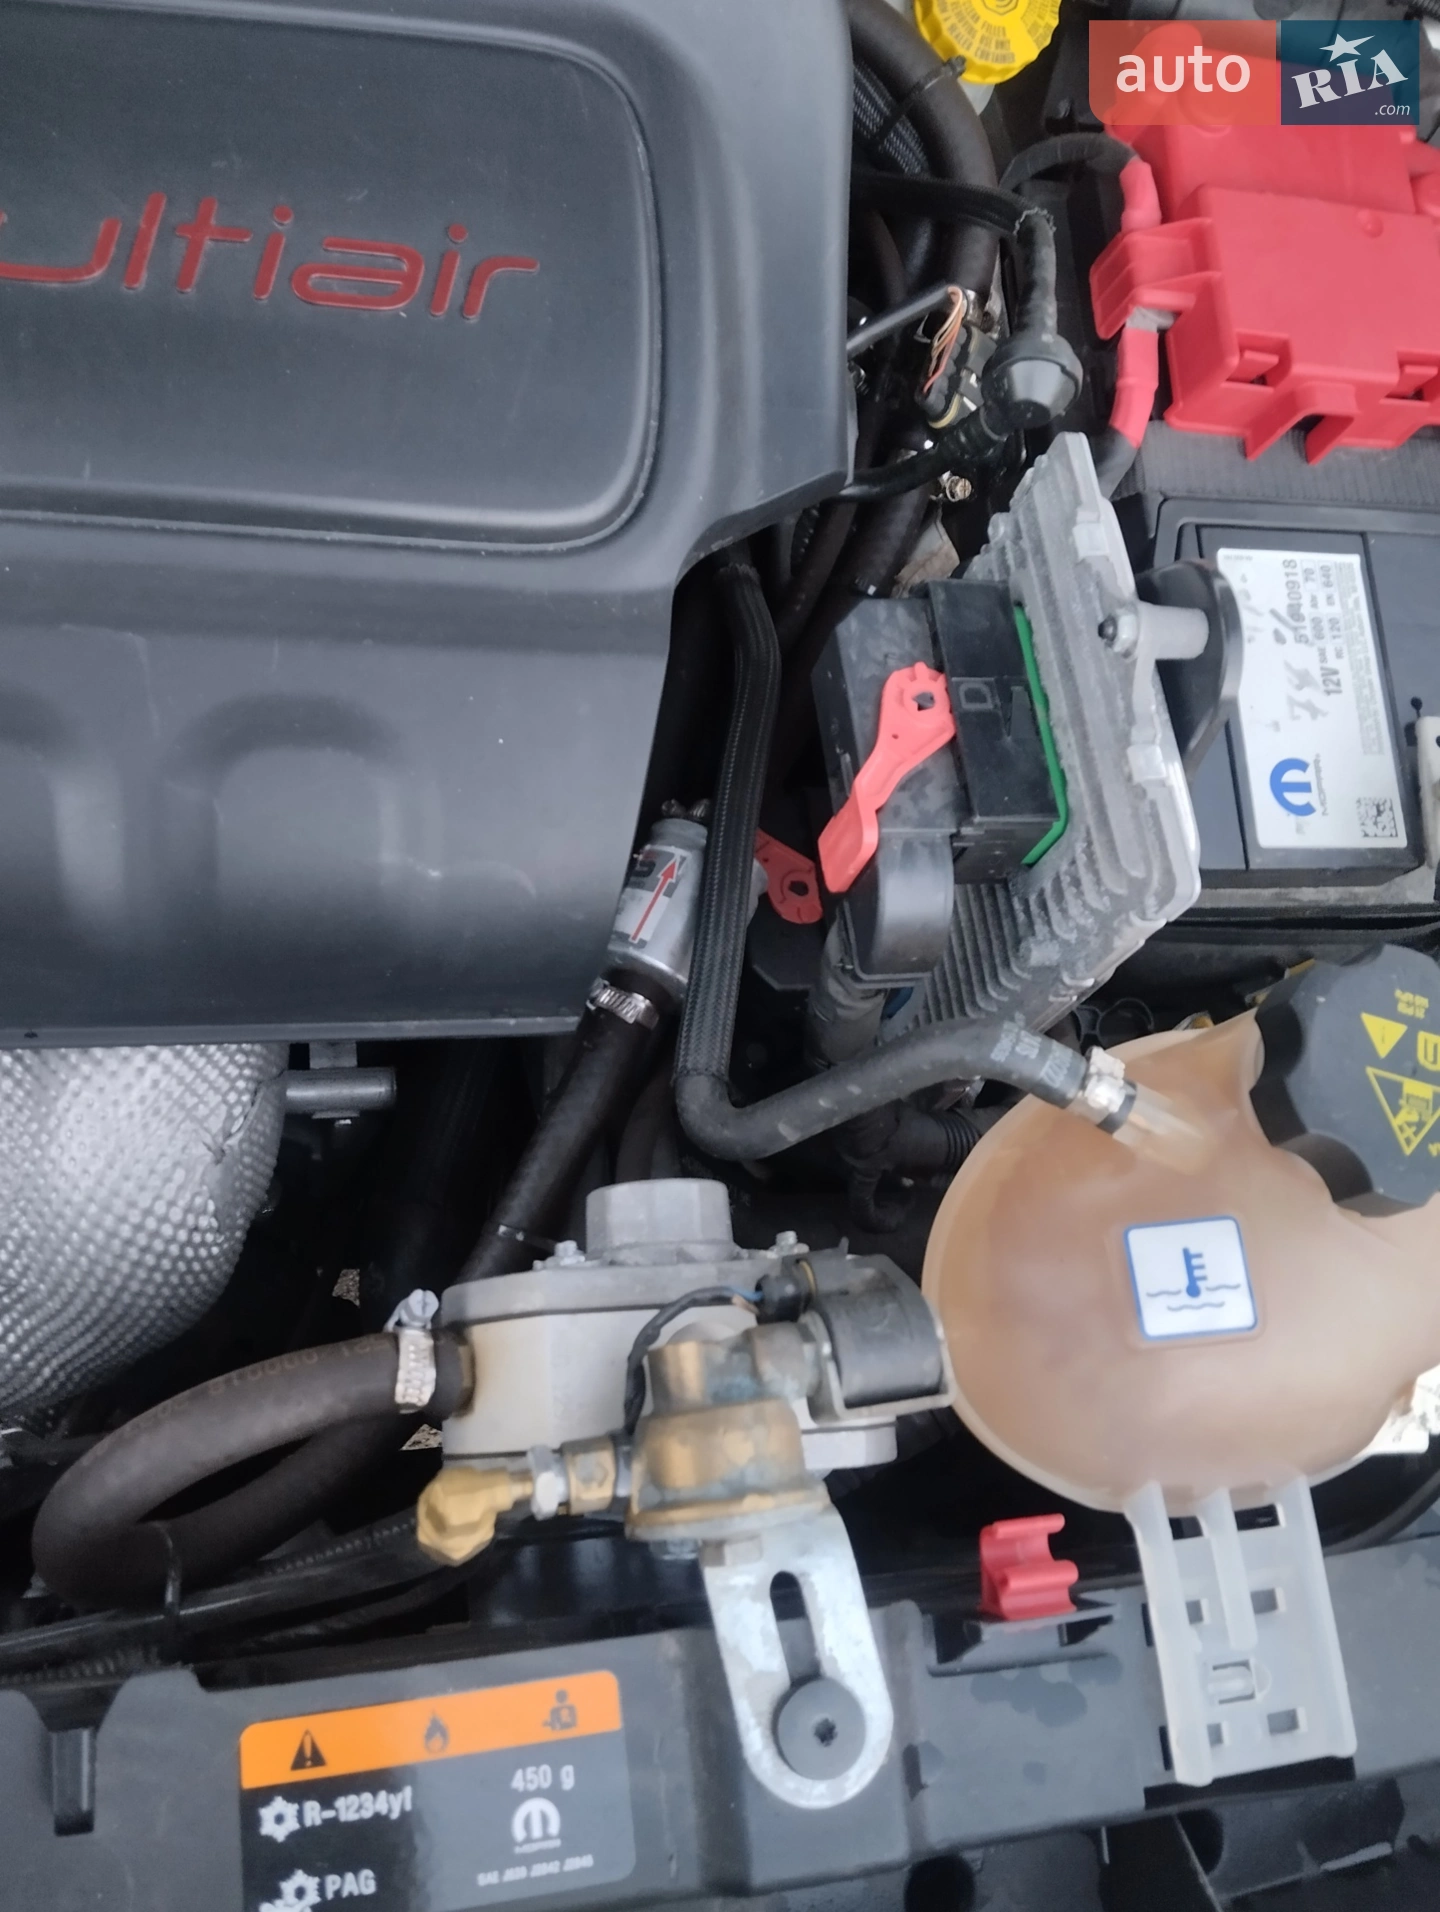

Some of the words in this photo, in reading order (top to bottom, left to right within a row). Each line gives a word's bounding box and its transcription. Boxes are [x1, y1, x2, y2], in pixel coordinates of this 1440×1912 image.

[1303, 568, 1316, 583] 70
[1328, 616, 1342, 640] 120
[1320, 666, 1343, 697] 12V
[510, 1764, 553, 1792] 450
[560, 1764, 576, 1791] g
[303, 1786, 413, 1828] R-1234yf
[325, 1868, 377, 1900] PAG
